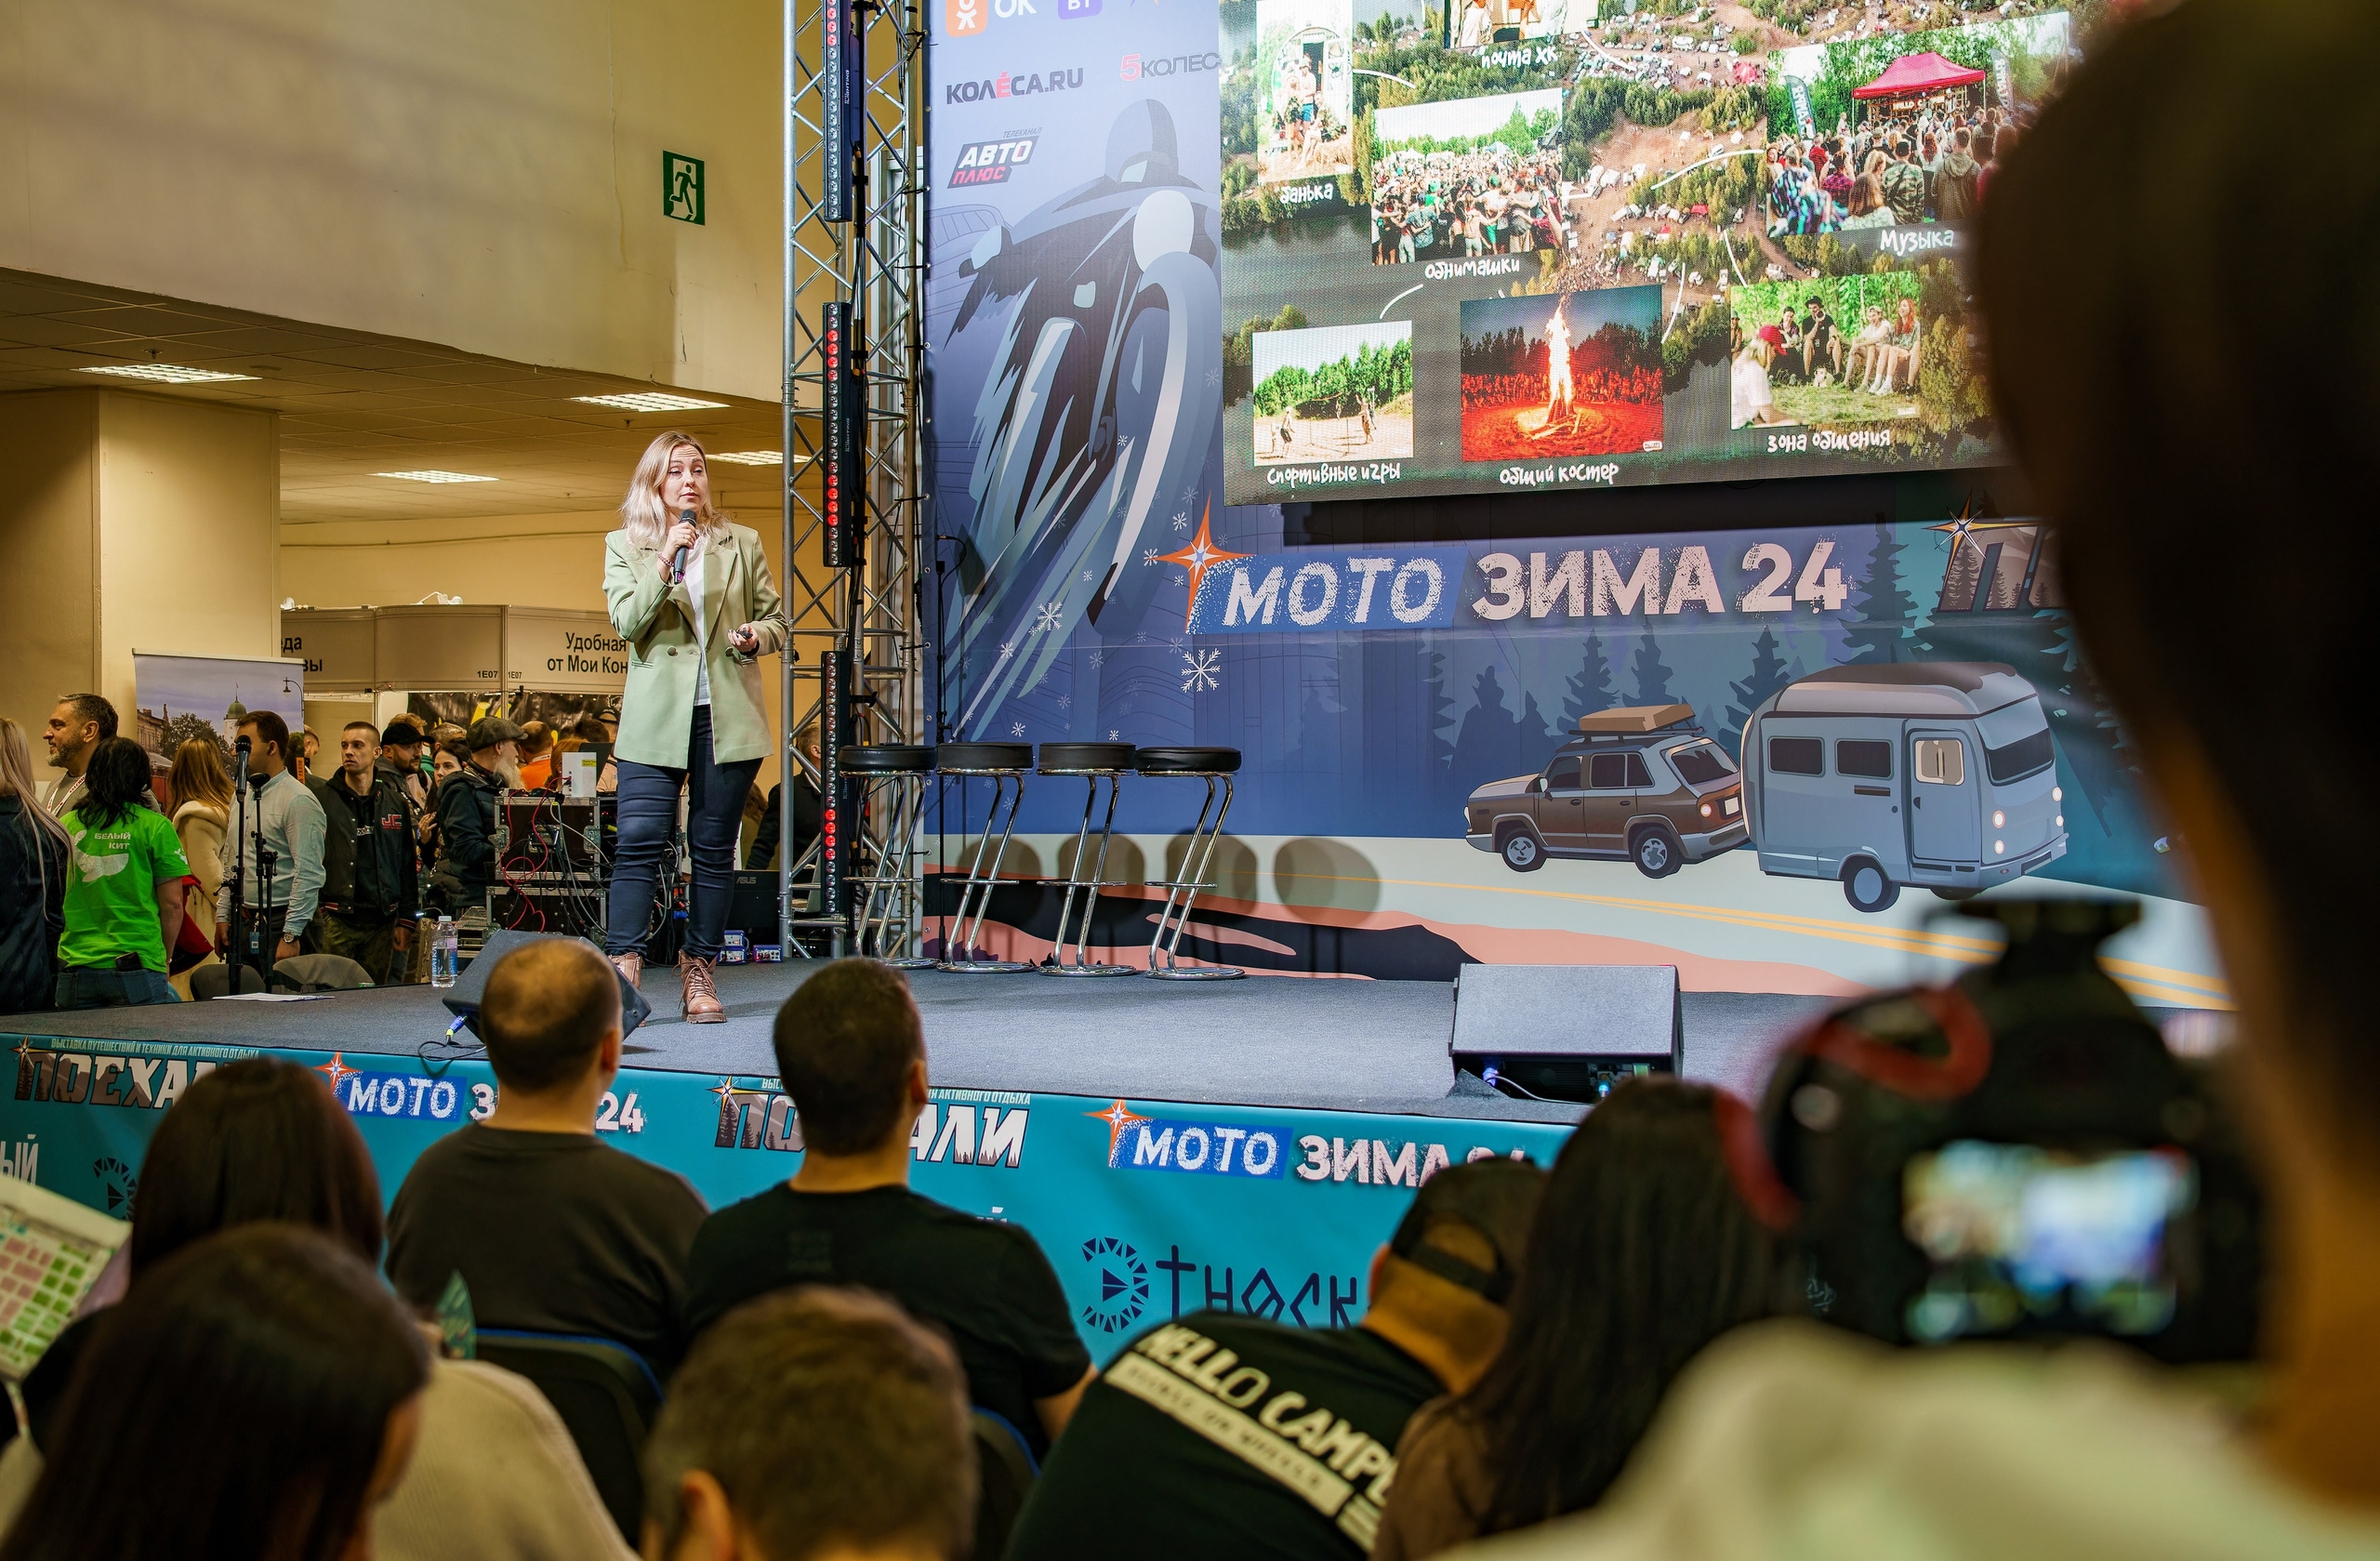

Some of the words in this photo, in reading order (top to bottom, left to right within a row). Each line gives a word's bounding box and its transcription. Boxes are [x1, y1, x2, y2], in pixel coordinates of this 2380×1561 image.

[1002, 126, 1043, 139] ТЕЛЕКАНАЛ
[958, 139, 1034, 169] АВТО
[952, 165, 1007, 185] ПЛЮС
[1221, 556, 1445, 628] МОТО
[1470, 545, 1726, 621] ЗИМА
[1736, 538, 1849, 615] 24
[281, 637, 302, 653] да
[565, 631, 627, 654] Удобная
[547, 657, 564, 671] от
[567, 655, 599, 673] Мои
[477, 670, 498, 679] 1E07
[508, 671, 522, 680] 1E07
[94, 831, 132, 840] БЕЛЫЙ
[109, 841, 131, 851] КИТ
[51, 1038, 86, 1051] ВЫСТАВКА
[87, 1040, 136, 1054] ПУТЕШЕСТВИЙ
[141, 1043, 172, 1056] ТЕХНИКИ
[172, 1044, 188, 1057] ДЛЯ
[188, 1046, 228, 1059] АКТИВНОГО
[14, 1052, 220, 1109] ПОЕХА
[347, 1077, 458, 1119] МОТО
[938, 1089, 992, 1103] АКТИВНОГО
[991, 1091, 1031, 1105] ОТДЫХА
[714, 1093, 1030, 1169] ПОАЛИ
[1132, 1125, 1281, 1177] МОТО
[1134, 1322, 1272, 1409] HELLO
[1258, 1390, 1398, 1509] CAMPE
